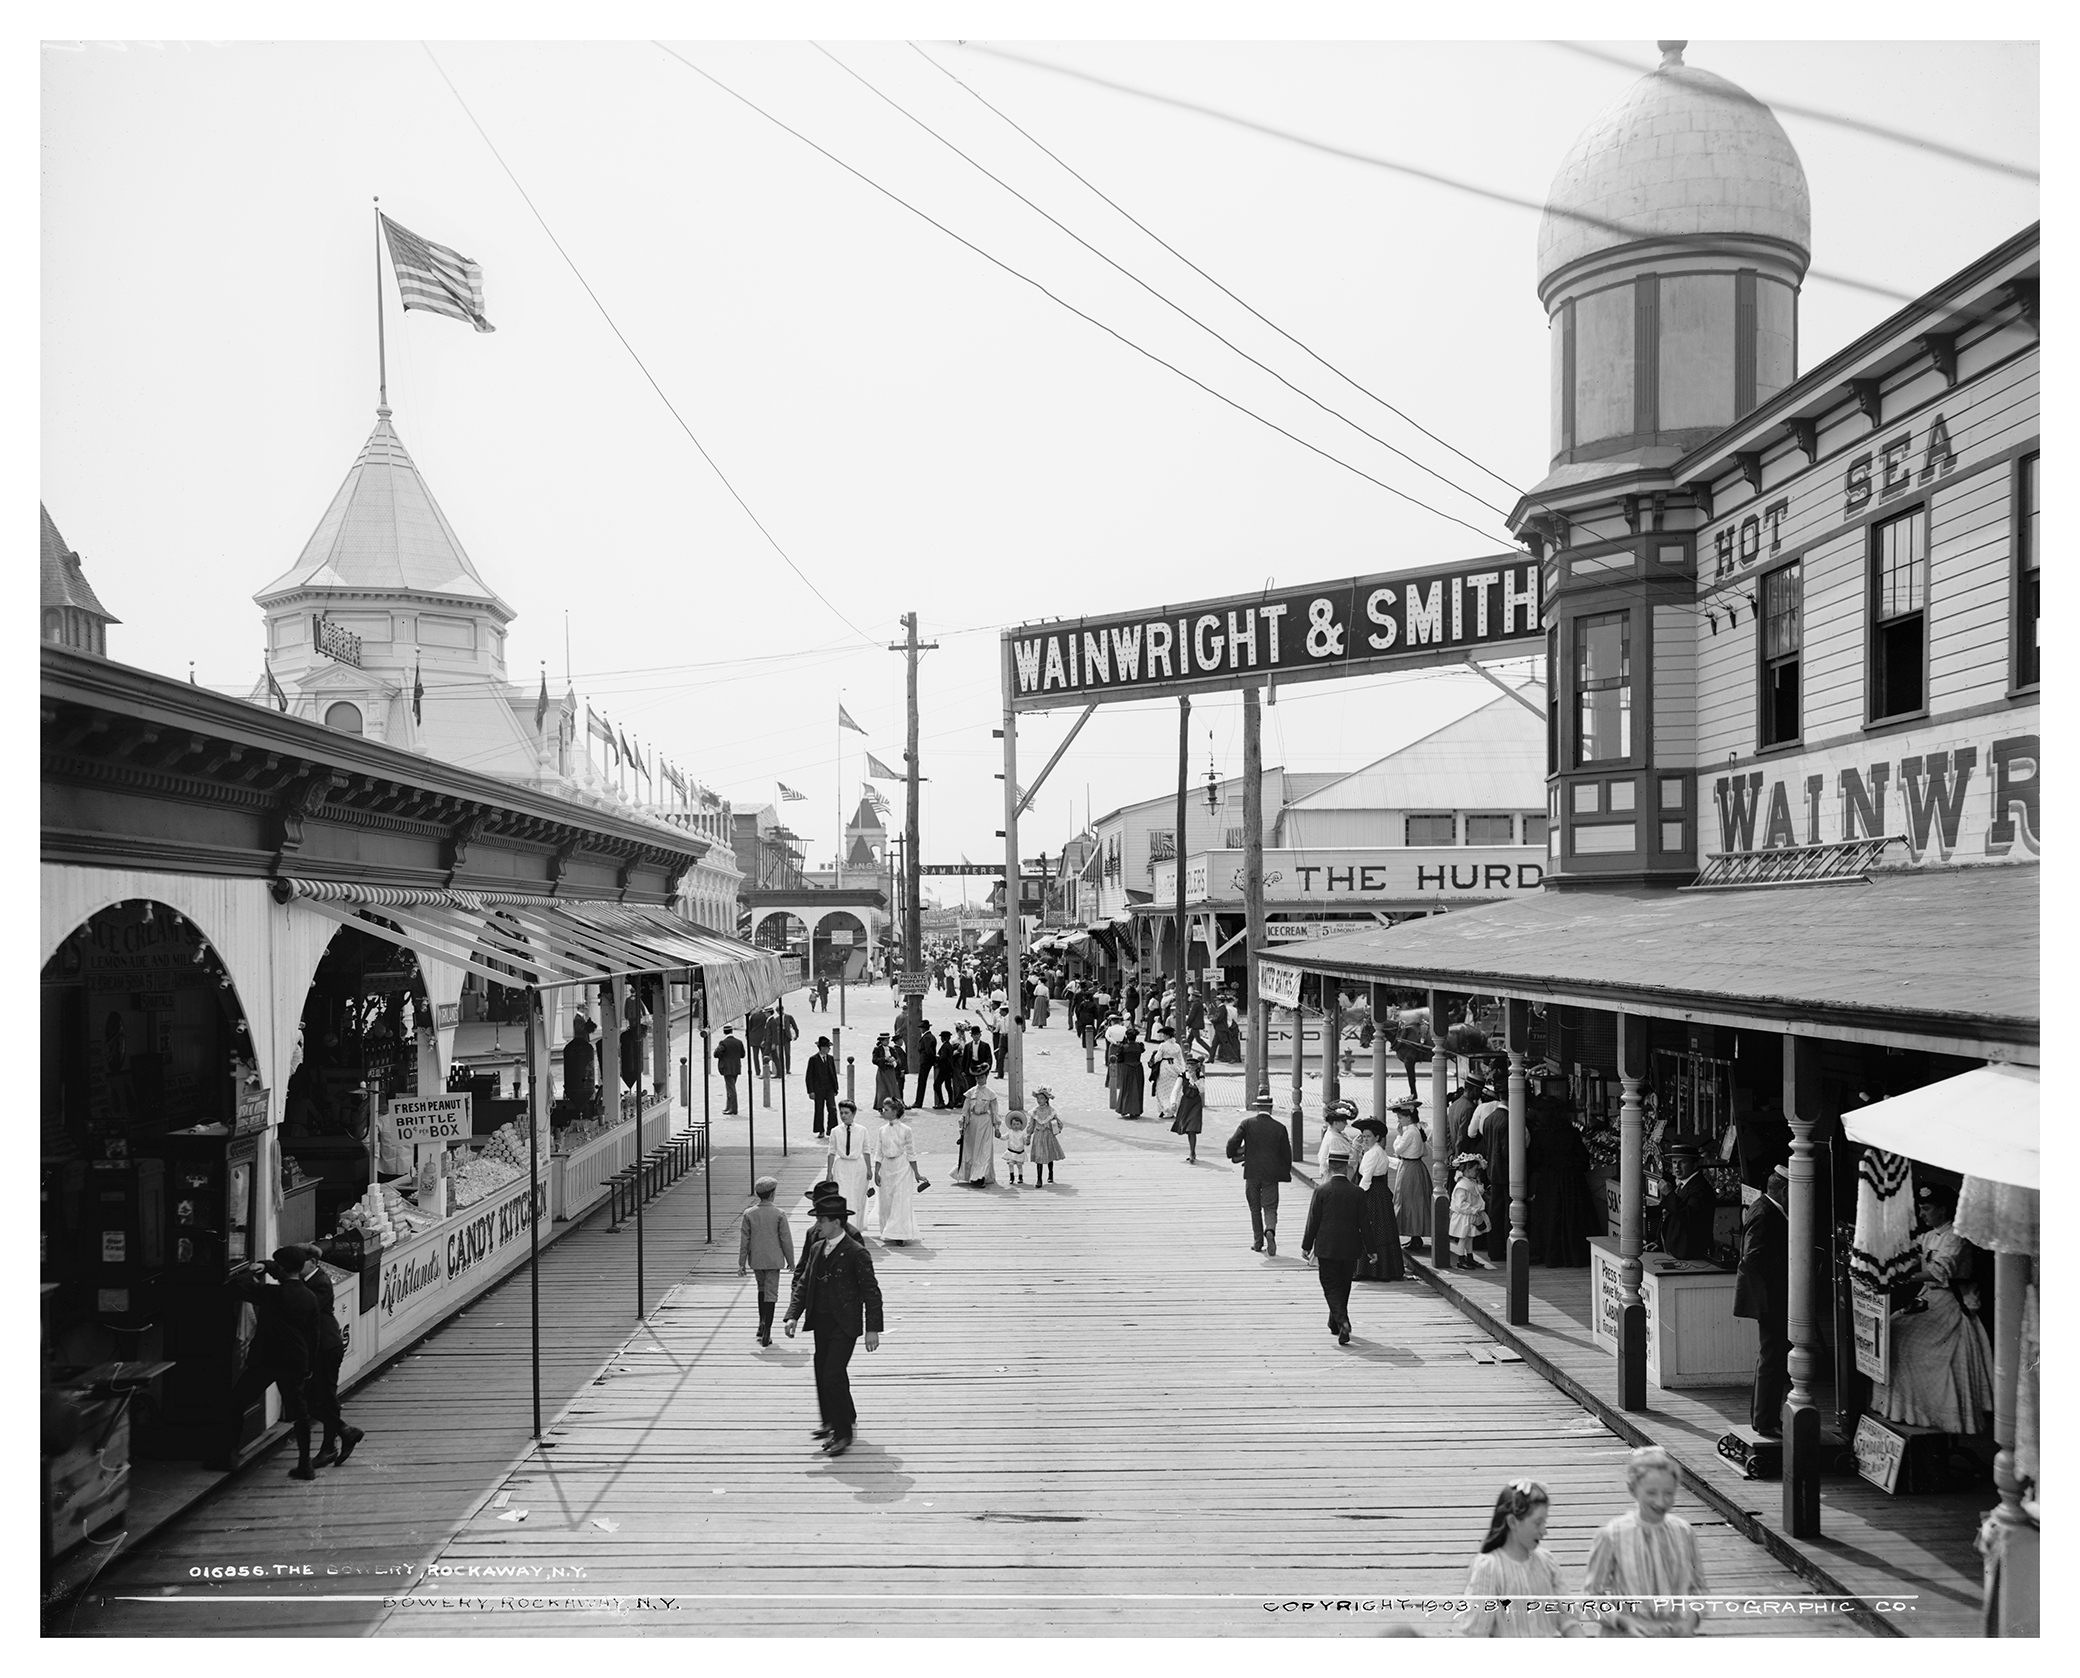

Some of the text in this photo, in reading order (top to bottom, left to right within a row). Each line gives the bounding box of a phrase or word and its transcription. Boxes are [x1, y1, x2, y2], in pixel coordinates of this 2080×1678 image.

[1714, 413, 1958, 582] HOT SEA
[1014, 565, 1538, 692] WAINWRIGHT & SMITH
[1714, 734, 2040, 865] WAINWR
[953, 865, 996, 876] MYERS
[1296, 863, 1543, 892] THE HURD
[1268, 926, 1280, 936] ICE
[1280, 926, 1307, 936] CREAM
[394, 1099, 461, 1115] FRESH PEANUT
[396, 1113, 456, 1127] BRITTLE
[430, 1124, 460, 1139] BOX
[447, 1210, 496, 1281] CANDY
[1602, 1259, 1617, 1284] PRESS
